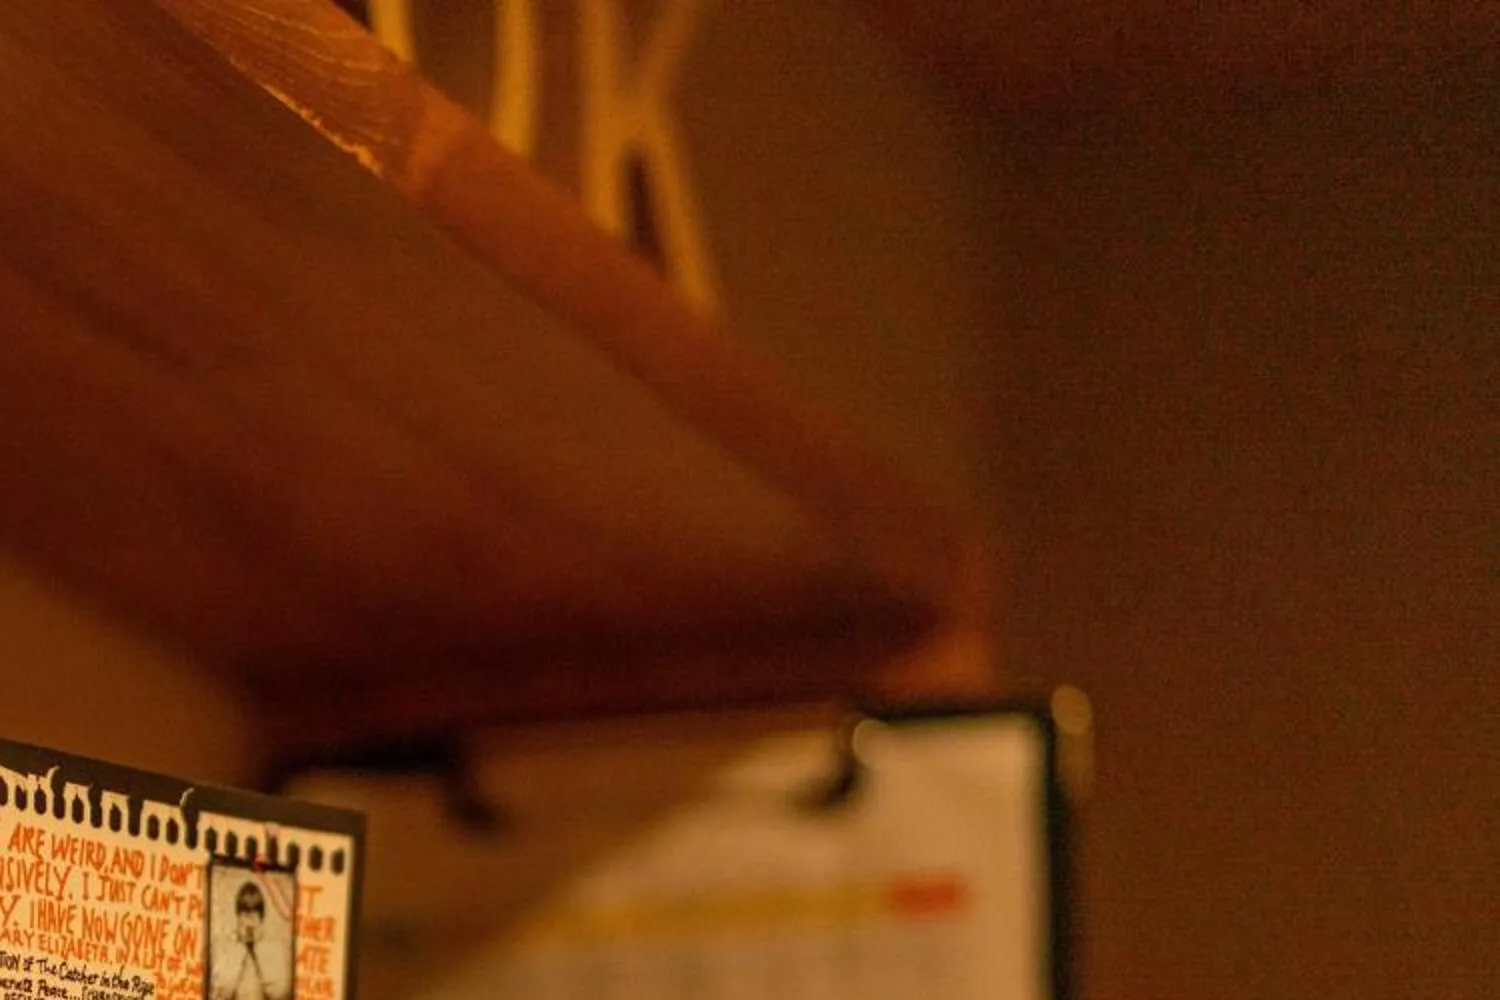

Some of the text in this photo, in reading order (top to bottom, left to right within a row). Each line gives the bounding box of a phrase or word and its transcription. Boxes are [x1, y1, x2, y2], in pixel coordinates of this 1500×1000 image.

[7, 821, 44, 857] ARE
[111, 845, 143, 877] AND
[150, 855, 155, 879] I
[82, 871, 88, 899] I
[98, 875, 135, 904] JUST
[37, 898, 74, 935] HAVE
[82, 906, 117, 944] NOW
[122, 912, 169, 958] GONE
[36, 958, 56, 976] The
[60, 961, 98, 986] Catcher
